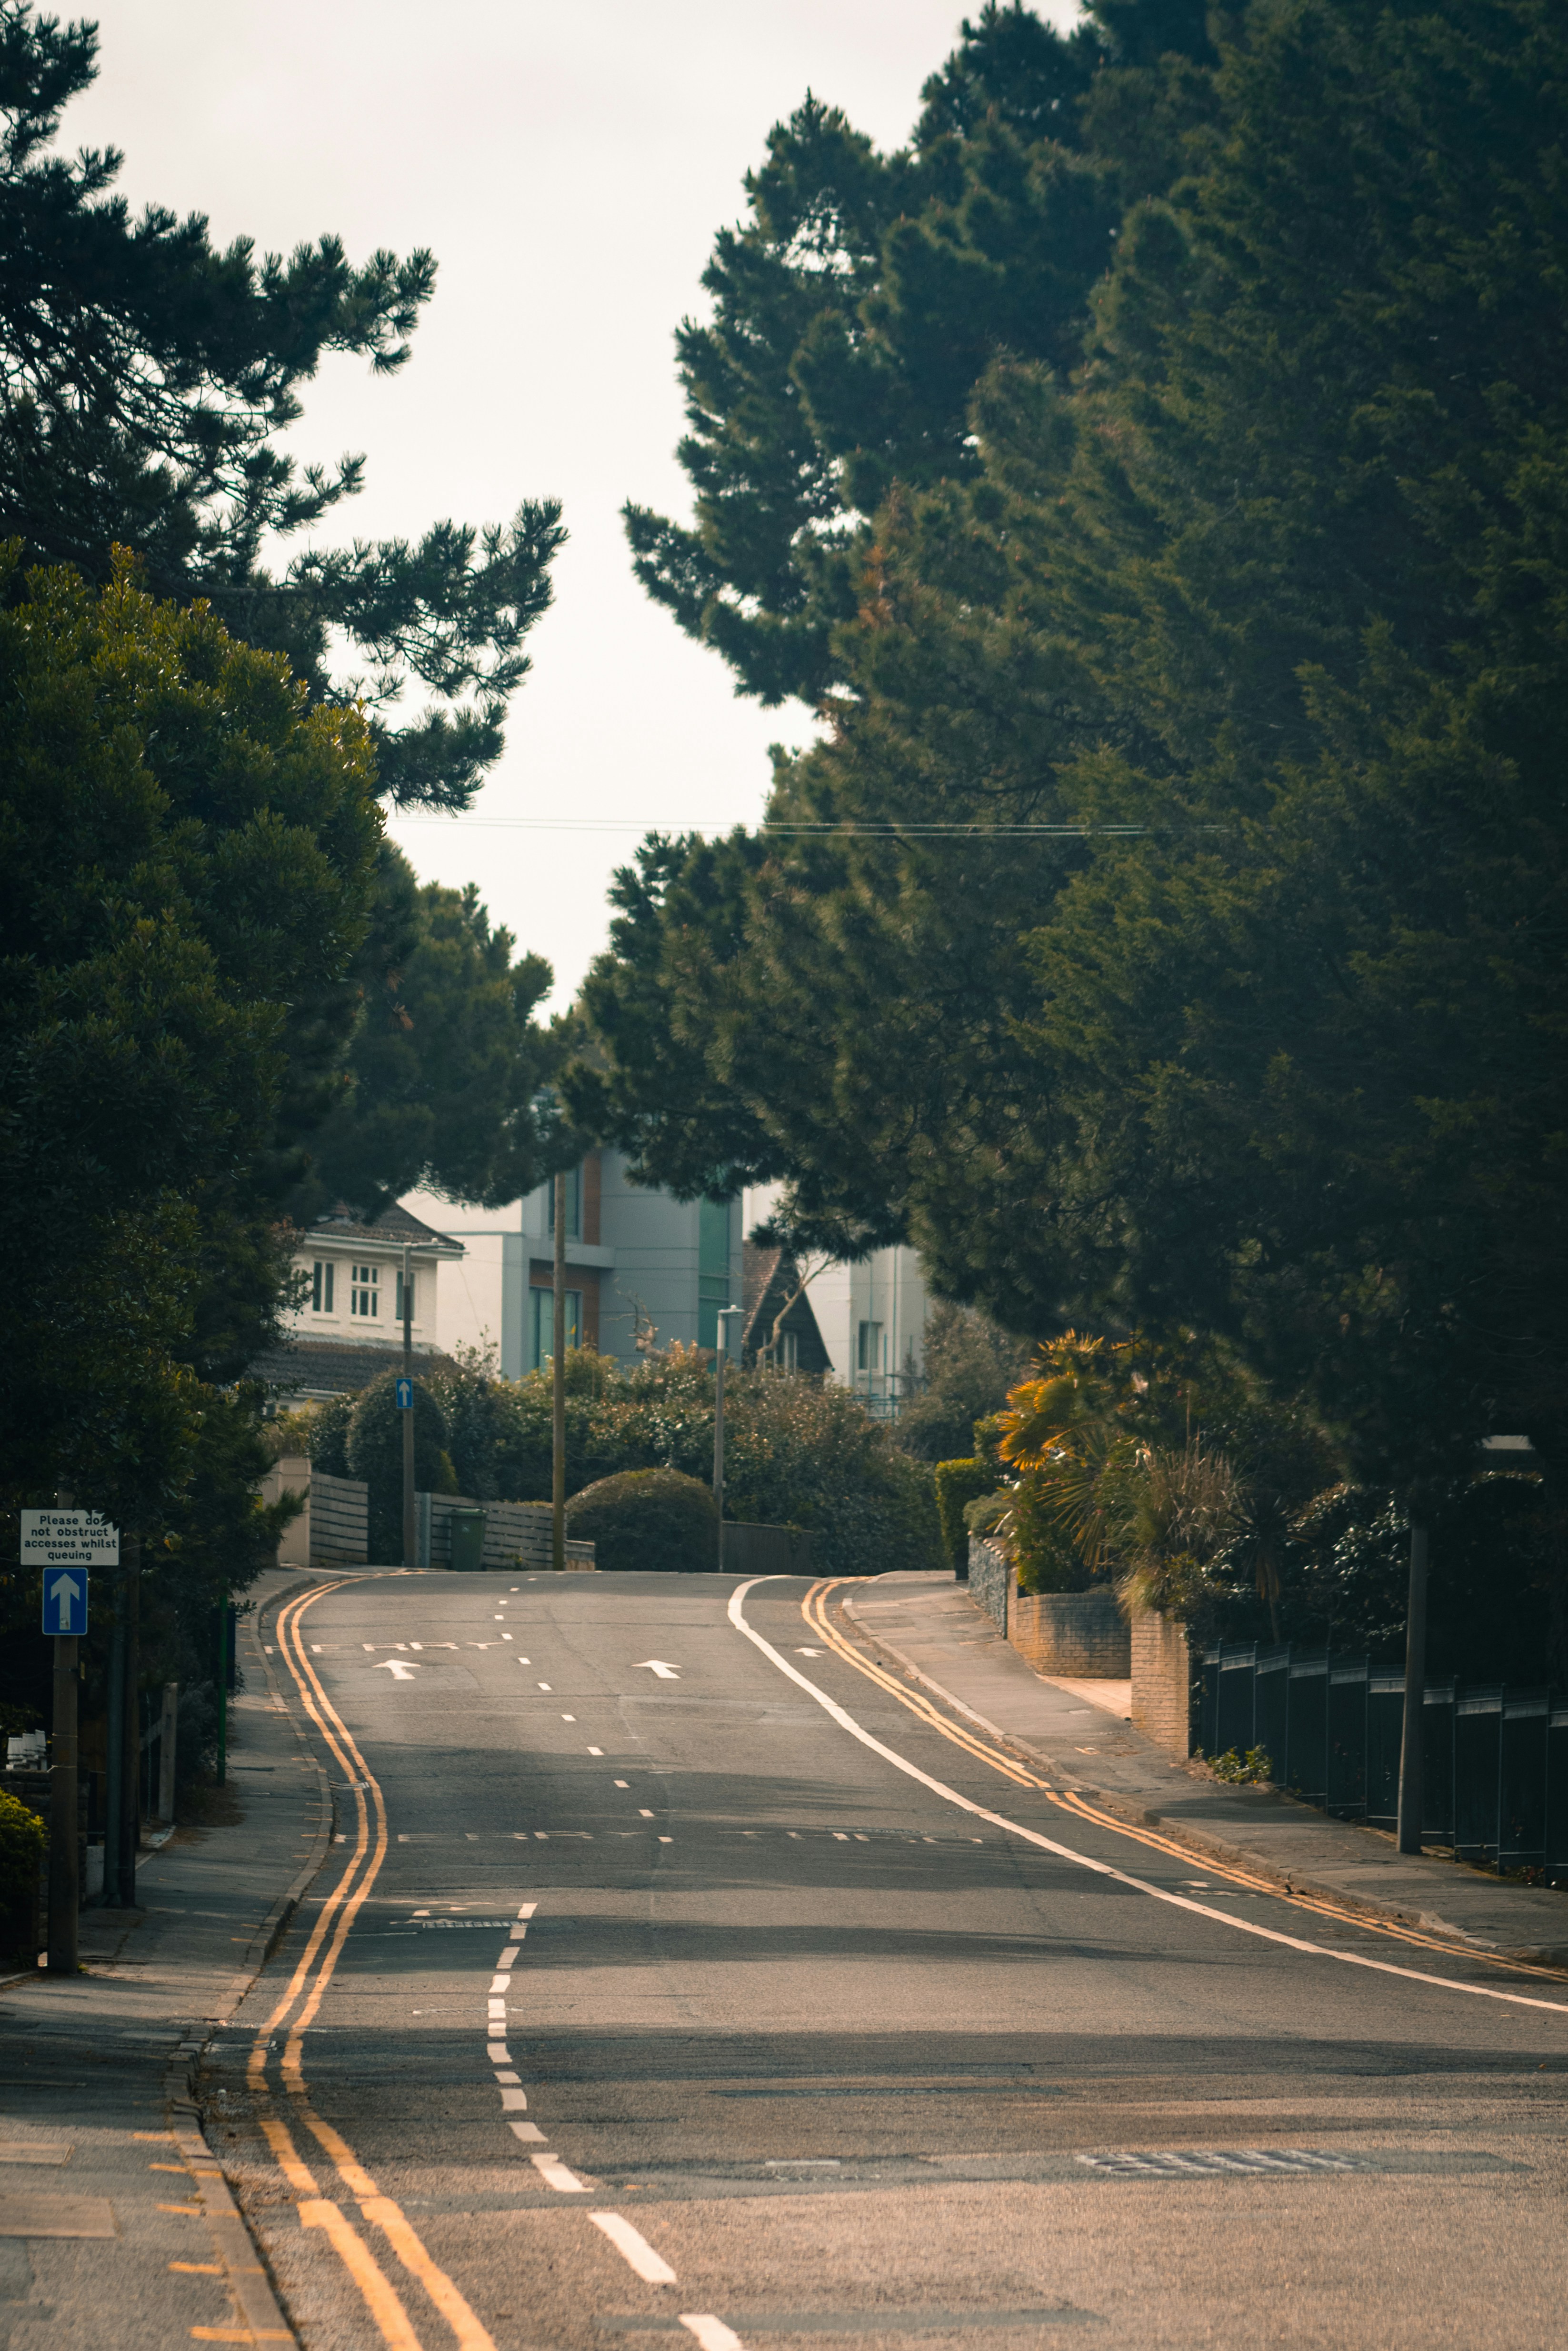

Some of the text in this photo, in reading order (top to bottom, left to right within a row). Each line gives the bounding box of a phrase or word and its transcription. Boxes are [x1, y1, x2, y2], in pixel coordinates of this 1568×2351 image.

[40, 1515, 100, 1525] Please do
[31, 1527, 109, 1536] not obstruct
[24, 1539, 117, 1548] accesses whilst
[48, 1551, 92, 1561] queuing
